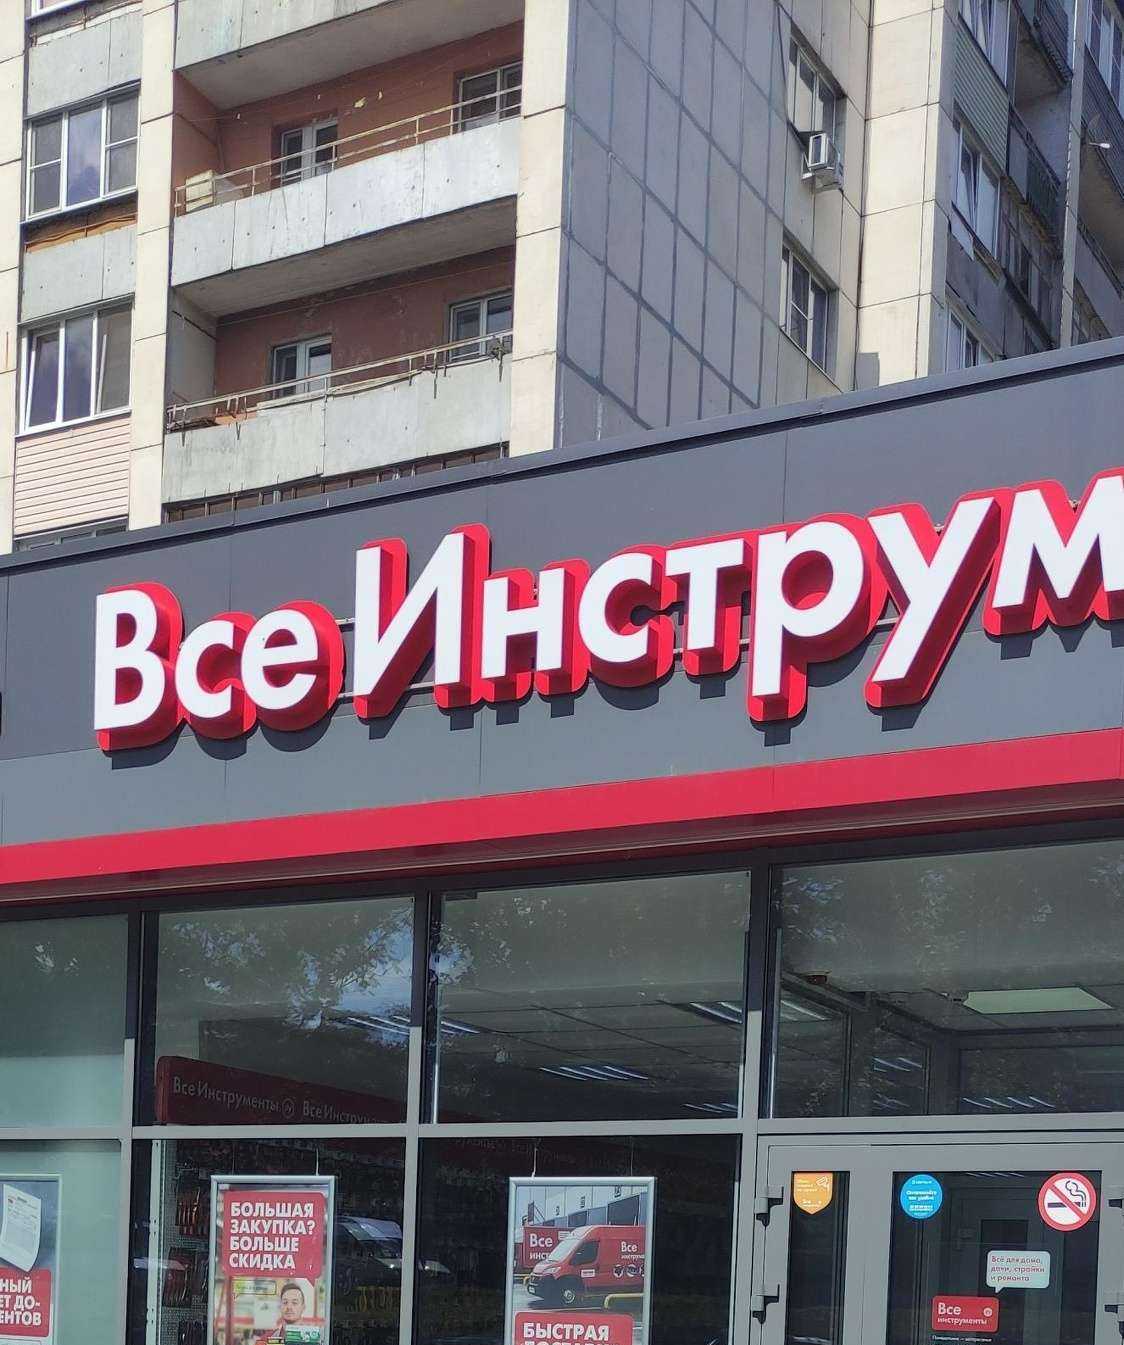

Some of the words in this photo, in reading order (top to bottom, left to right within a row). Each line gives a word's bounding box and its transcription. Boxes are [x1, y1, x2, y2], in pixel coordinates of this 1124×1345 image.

[230, 1202, 314, 1218] БОЛЬШАЯ
[230, 1219, 316, 1235] ЗАКУПКА?
[229, 1236, 299, 1252] БОЛЬШЕ
[529, 1233, 553, 1248] Все
[620, 1241, 638, 1253] Все
[229, 1253, 297, 1271] СКИДКА
[1014, 1266, 1045, 1274] стройки
[937, 1302, 961, 1315] Все
[937, 1317, 987, 1326] инструменты
[523, 1322, 610, 1341] БЫСТРАЯ
